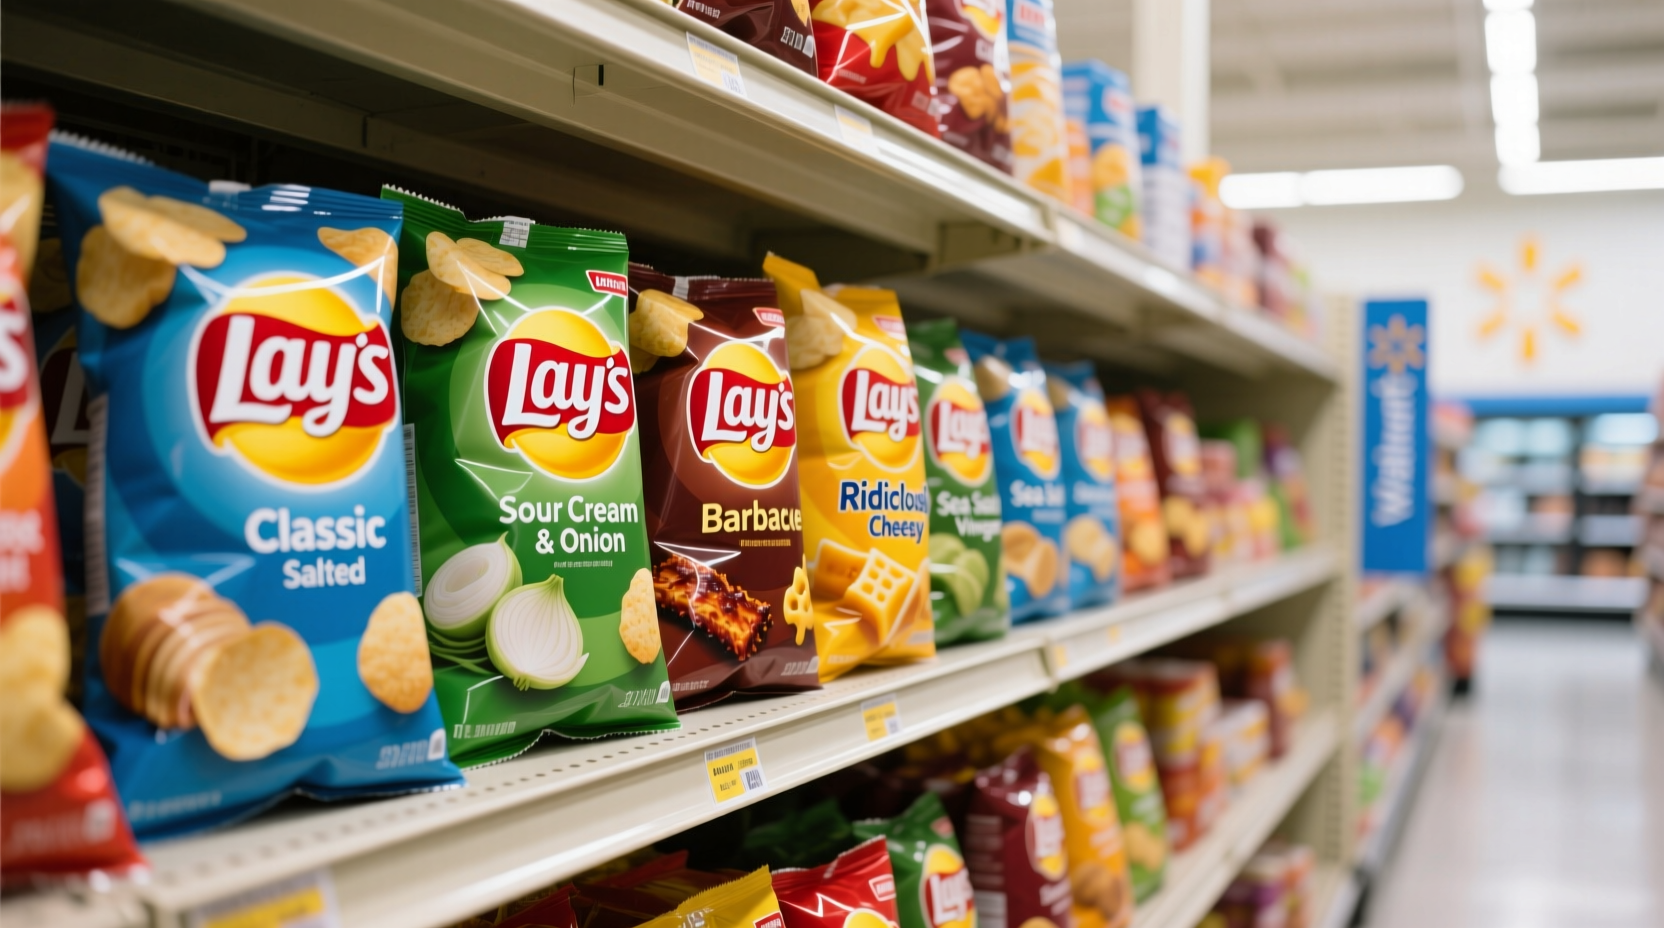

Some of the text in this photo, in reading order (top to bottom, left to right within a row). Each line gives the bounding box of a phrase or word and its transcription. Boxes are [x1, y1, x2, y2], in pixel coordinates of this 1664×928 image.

[208, 315, 390, 438] Lay's
[501, 342, 629, 440] Lay's
[701, 371, 794, 452] Lay's
[243, 504, 388, 554] Classic
[499, 495, 639, 524] Sour Cream
[535, 526, 626, 555] & Onion
[282, 556, 367, 590] Salted
